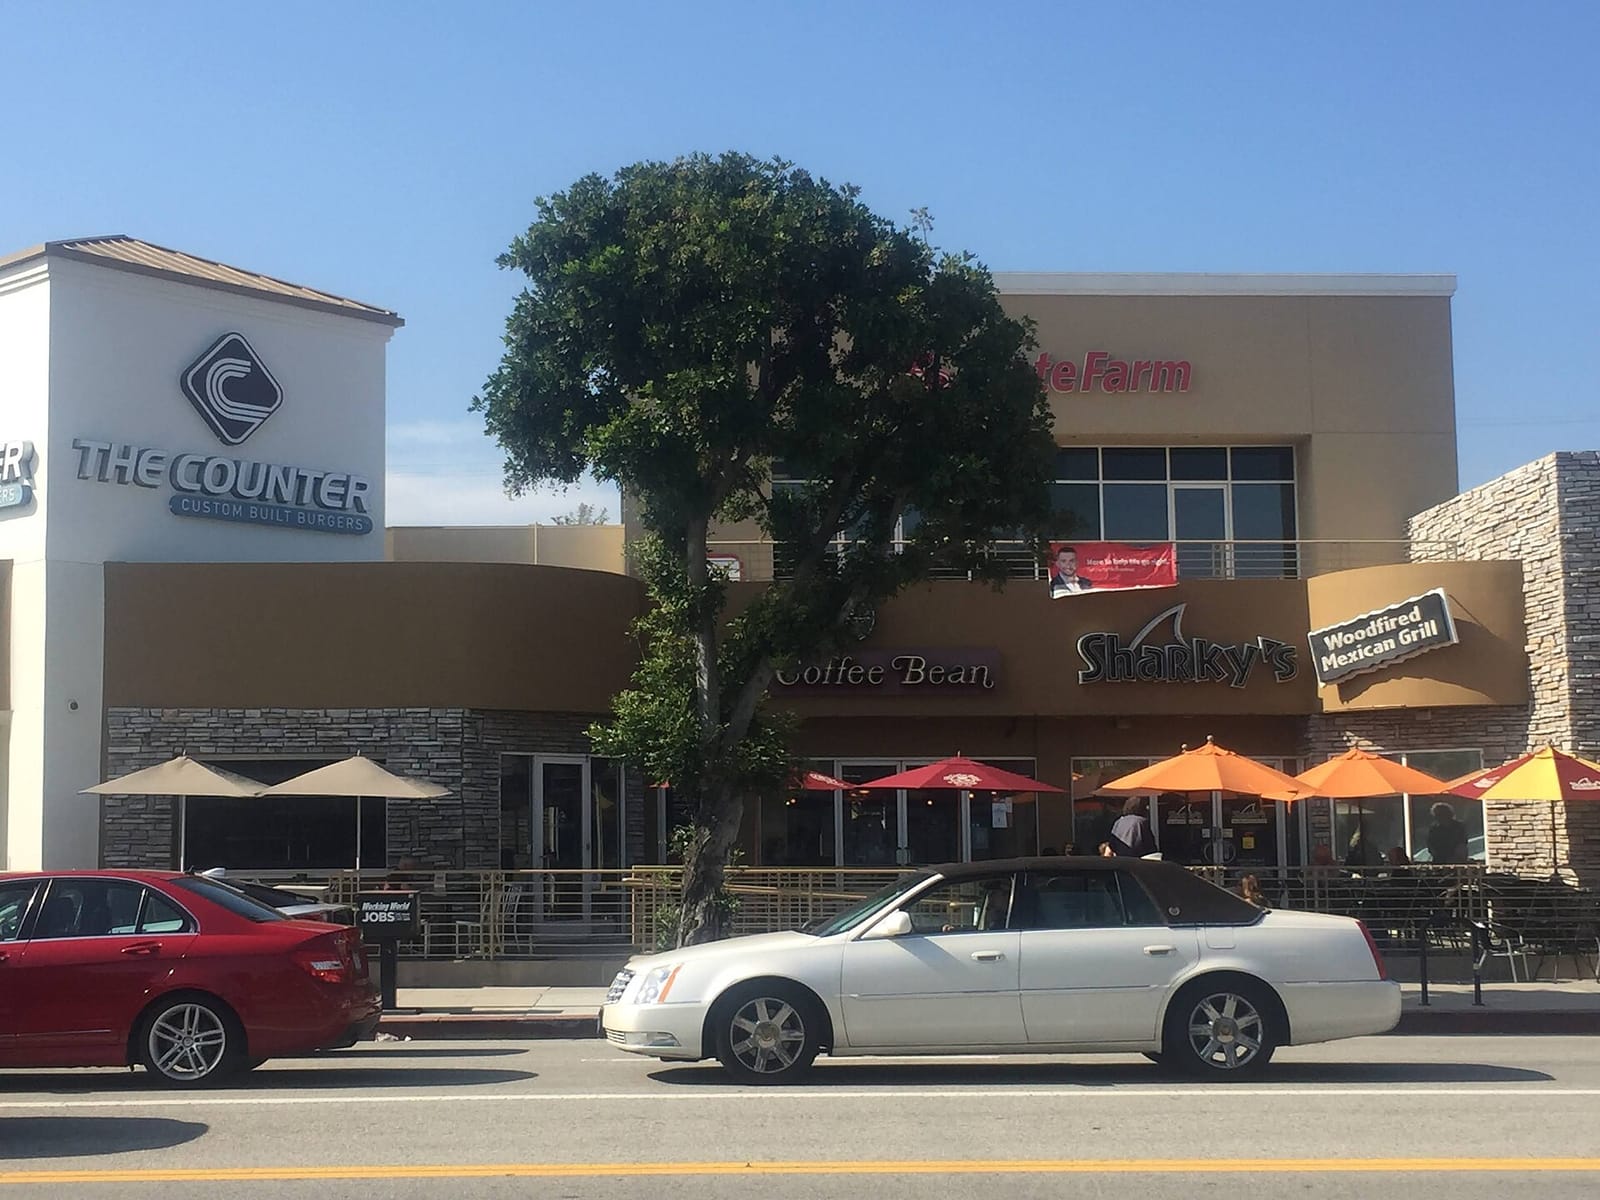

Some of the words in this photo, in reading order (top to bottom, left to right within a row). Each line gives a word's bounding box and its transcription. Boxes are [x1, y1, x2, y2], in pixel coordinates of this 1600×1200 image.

[1034, 351, 1193, 394] teFarm
[72, 438, 170, 489] THE
[169, 452, 372, 514] COUNTER
[181, 498, 243, 518] CUSTOM
[250, 507, 292, 523] BUILT
[298, 511, 363, 531] BURGERS
[1321, 638, 1396, 672] Mexican
[1398, 619, 1438, 646] Grill
[1323, 605, 1422, 651] Woodfired
[891, 655, 994, 689] Bean
[1076, 628, 1298, 688] Sharky's
[361, 911, 395, 922] JOBS
